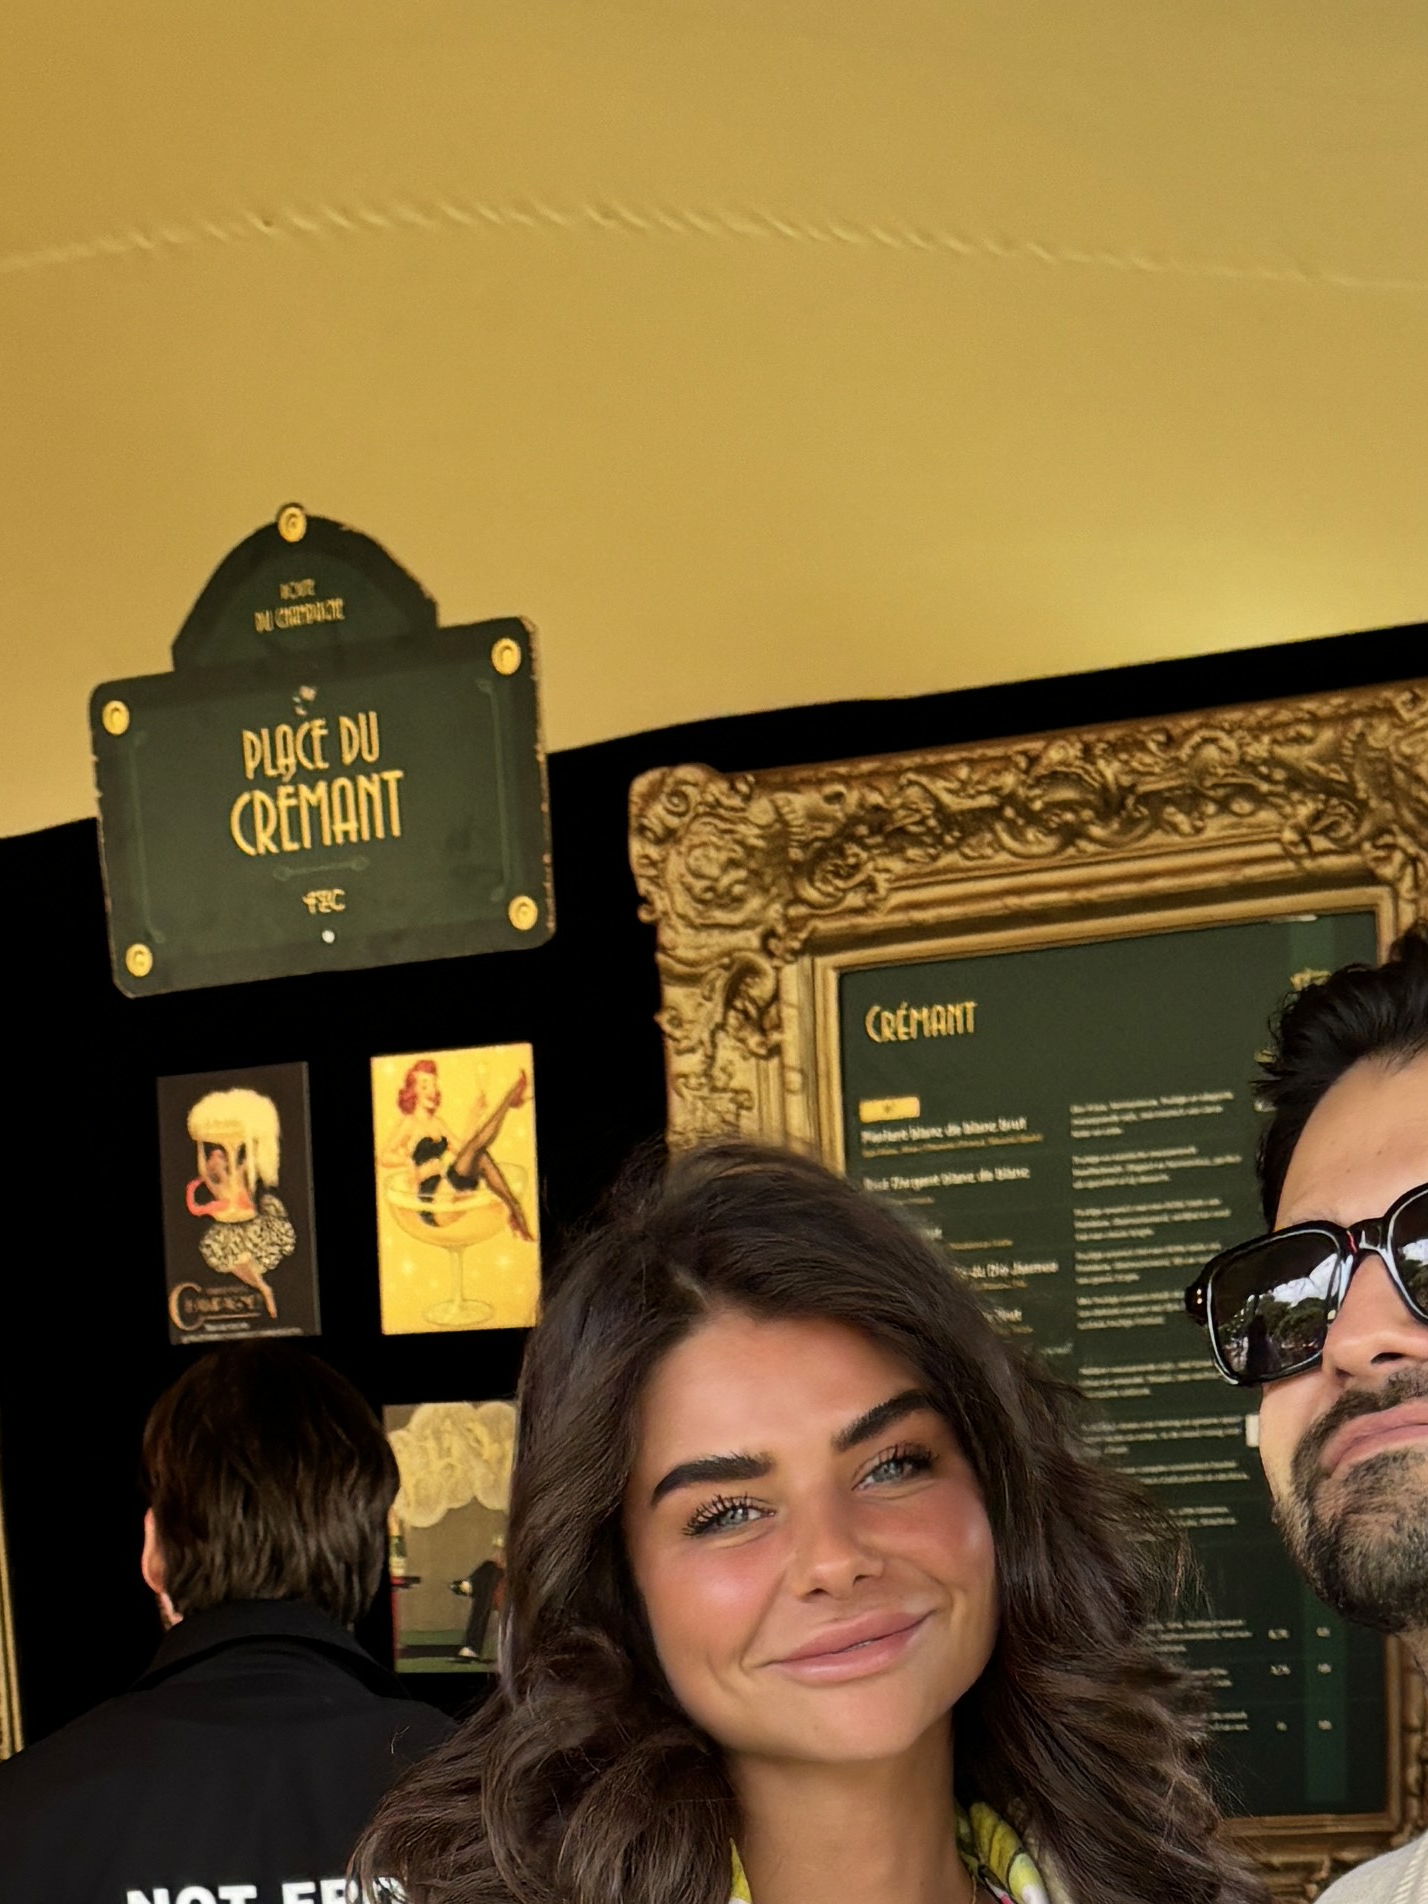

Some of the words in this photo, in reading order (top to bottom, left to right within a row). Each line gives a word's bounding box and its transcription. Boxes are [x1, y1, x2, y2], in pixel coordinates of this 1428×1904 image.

[242, 718, 329, 780] PLACE
[339, 711, 380, 765] DU
[230, 766, 403, 856] CRÉMANT
[864, 998, 978, 1043] CRÉMANT
